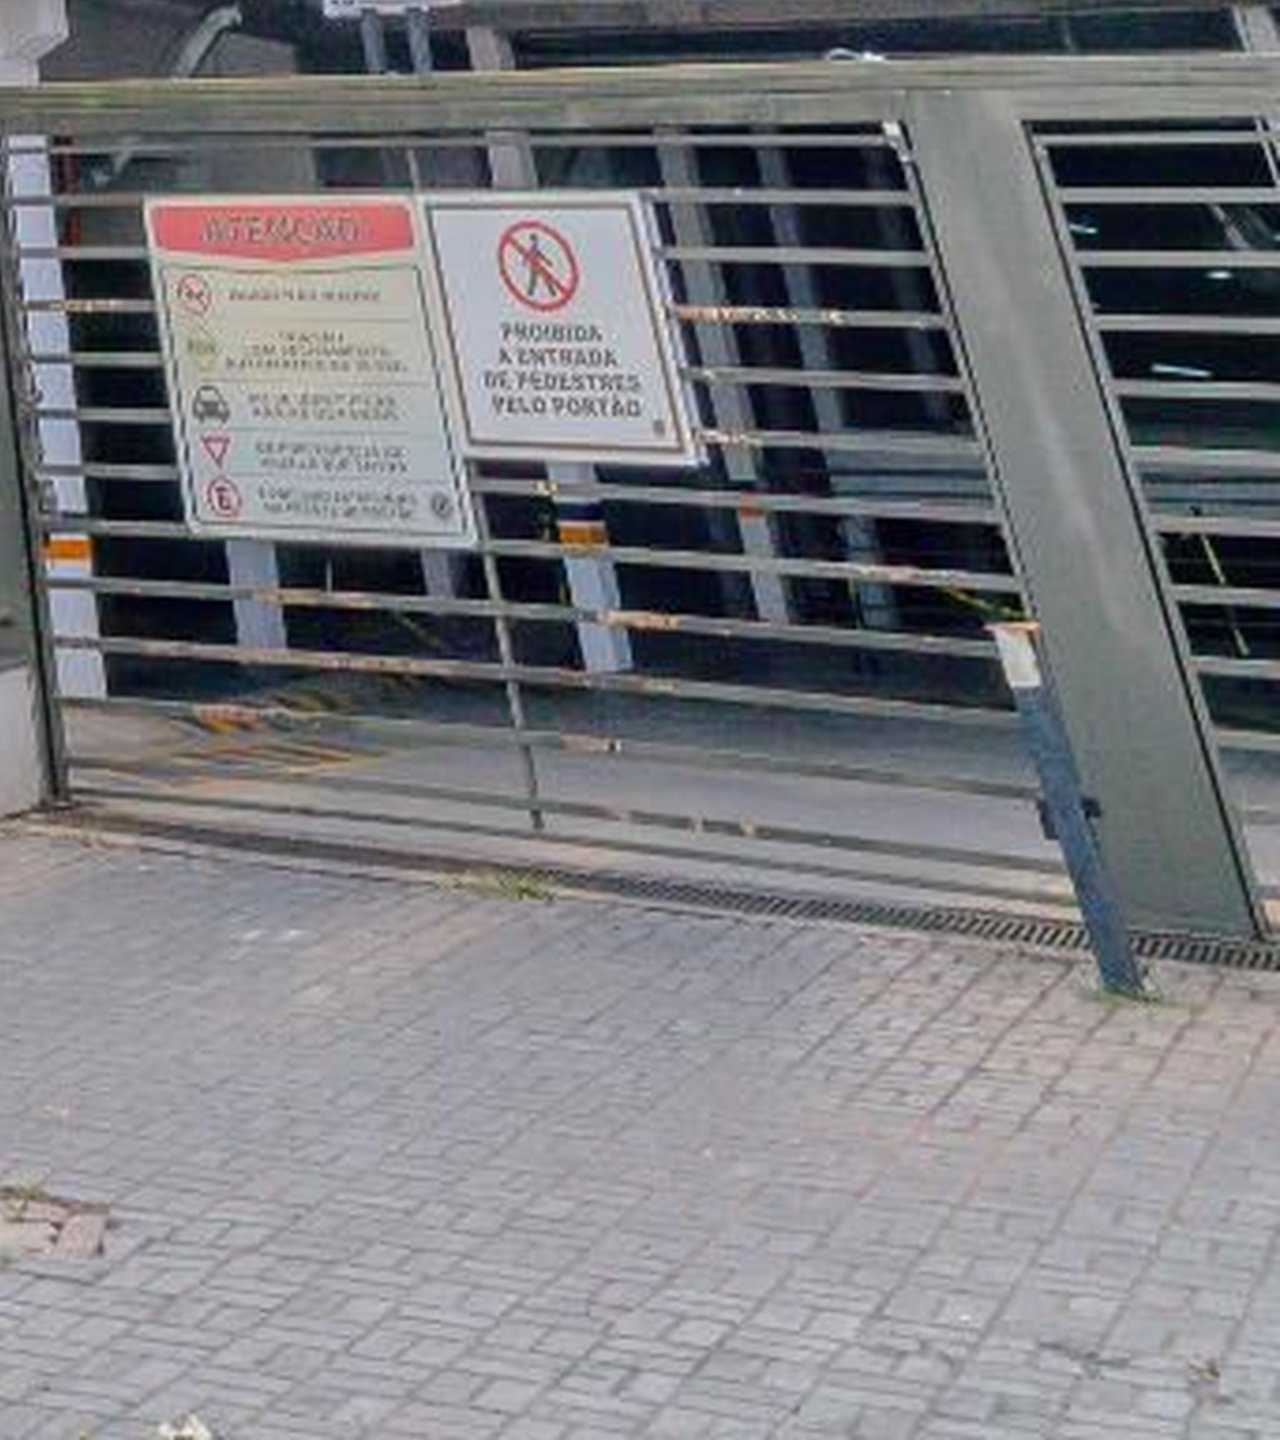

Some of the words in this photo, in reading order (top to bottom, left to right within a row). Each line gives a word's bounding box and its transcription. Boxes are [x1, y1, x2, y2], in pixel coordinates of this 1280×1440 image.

[500, 323, 602, 342] PROIBIDA
[499, 348, 512, 365] A
[518, 348, 618, 366] ENTRADA
[484, 371, 509, 390] DE
[517, 372, 642, 392] PEDESTRES
[492, 396, 547, 414] PELO
